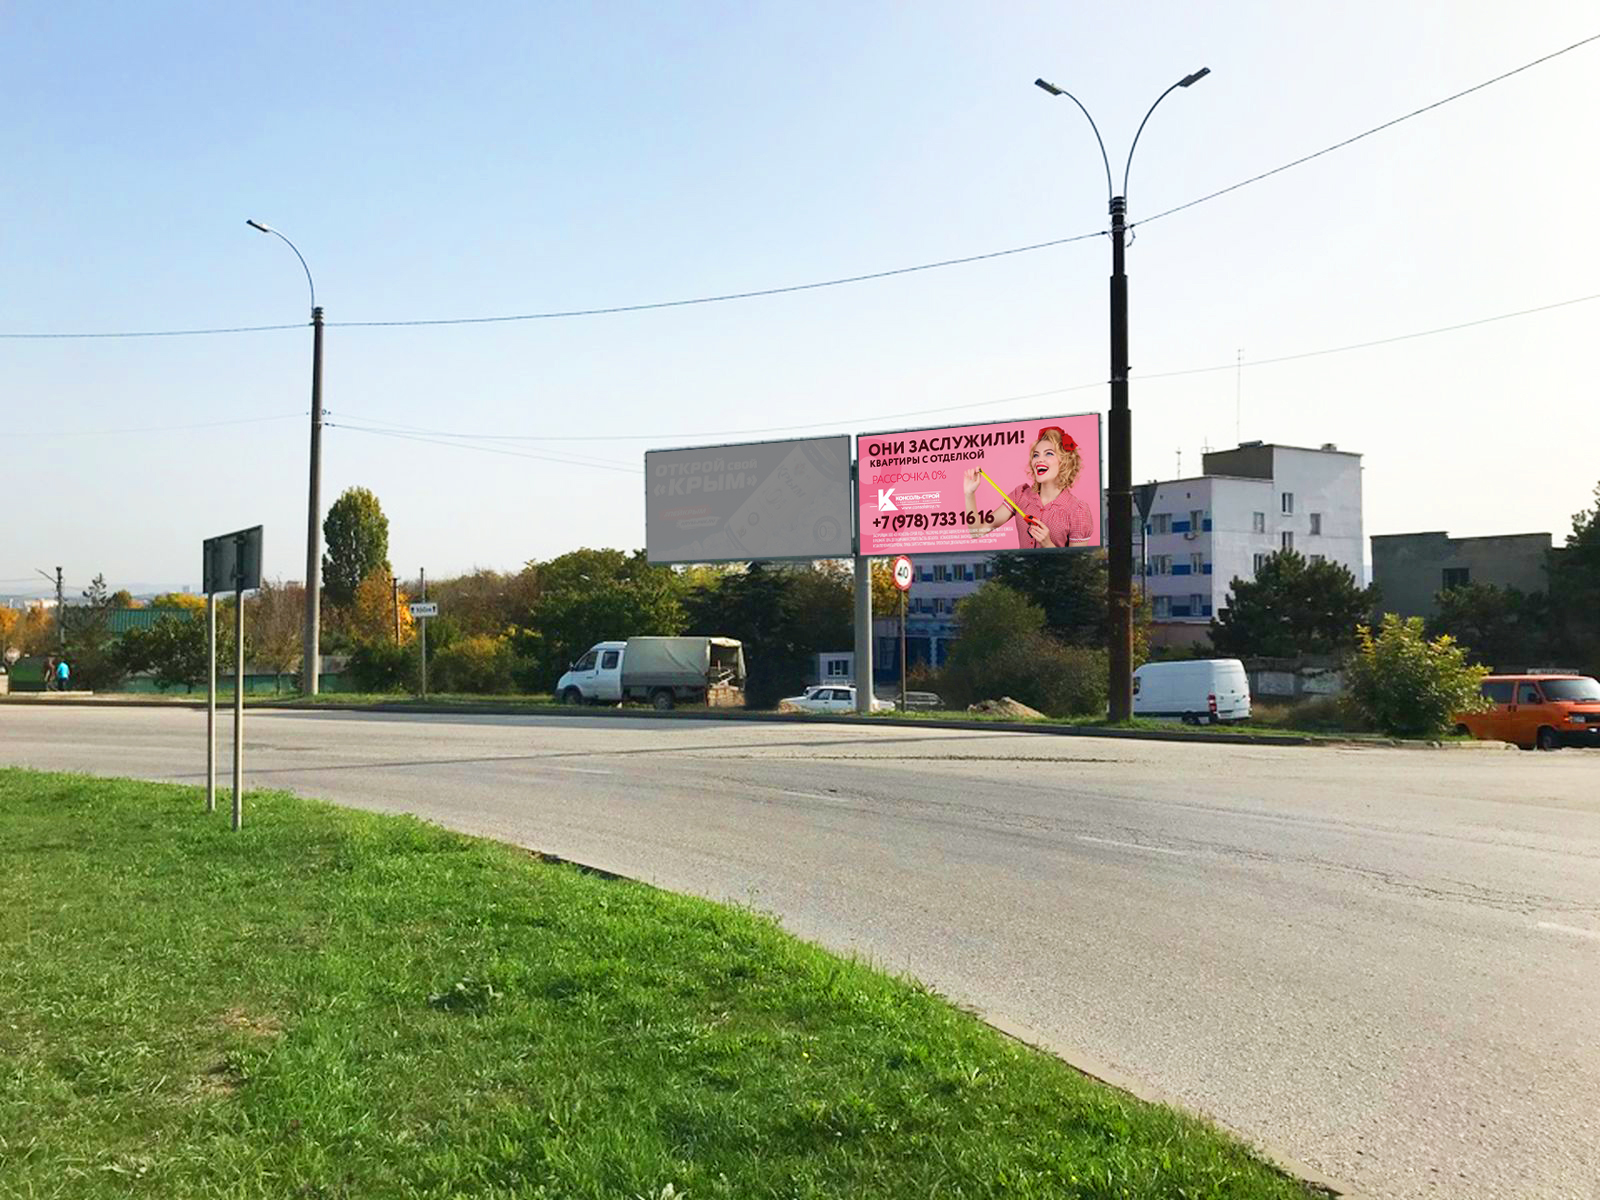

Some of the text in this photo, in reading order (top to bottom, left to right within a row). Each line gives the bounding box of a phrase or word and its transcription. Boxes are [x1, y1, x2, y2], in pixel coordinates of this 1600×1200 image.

[868, 429, 1025, 457] ОНИ ЗАСЛУЖИЛИ!
[655, 457, 725, 477] ОТКРОЙ
[869, 449, 985, 468] КВАРТИРЫ С ОТДЕЛКОЙ
[653, 471, 758, 497] «КРЫМ»
[872, 470, 947, 485] РАССРОЧКА 0%
[895, 492, 940, 502] КОНСОЛЬ-СТРОЙ
[872, 509, 995, 532] +7 (978) 733 16 16
[897, 566, 909, 579] 40
